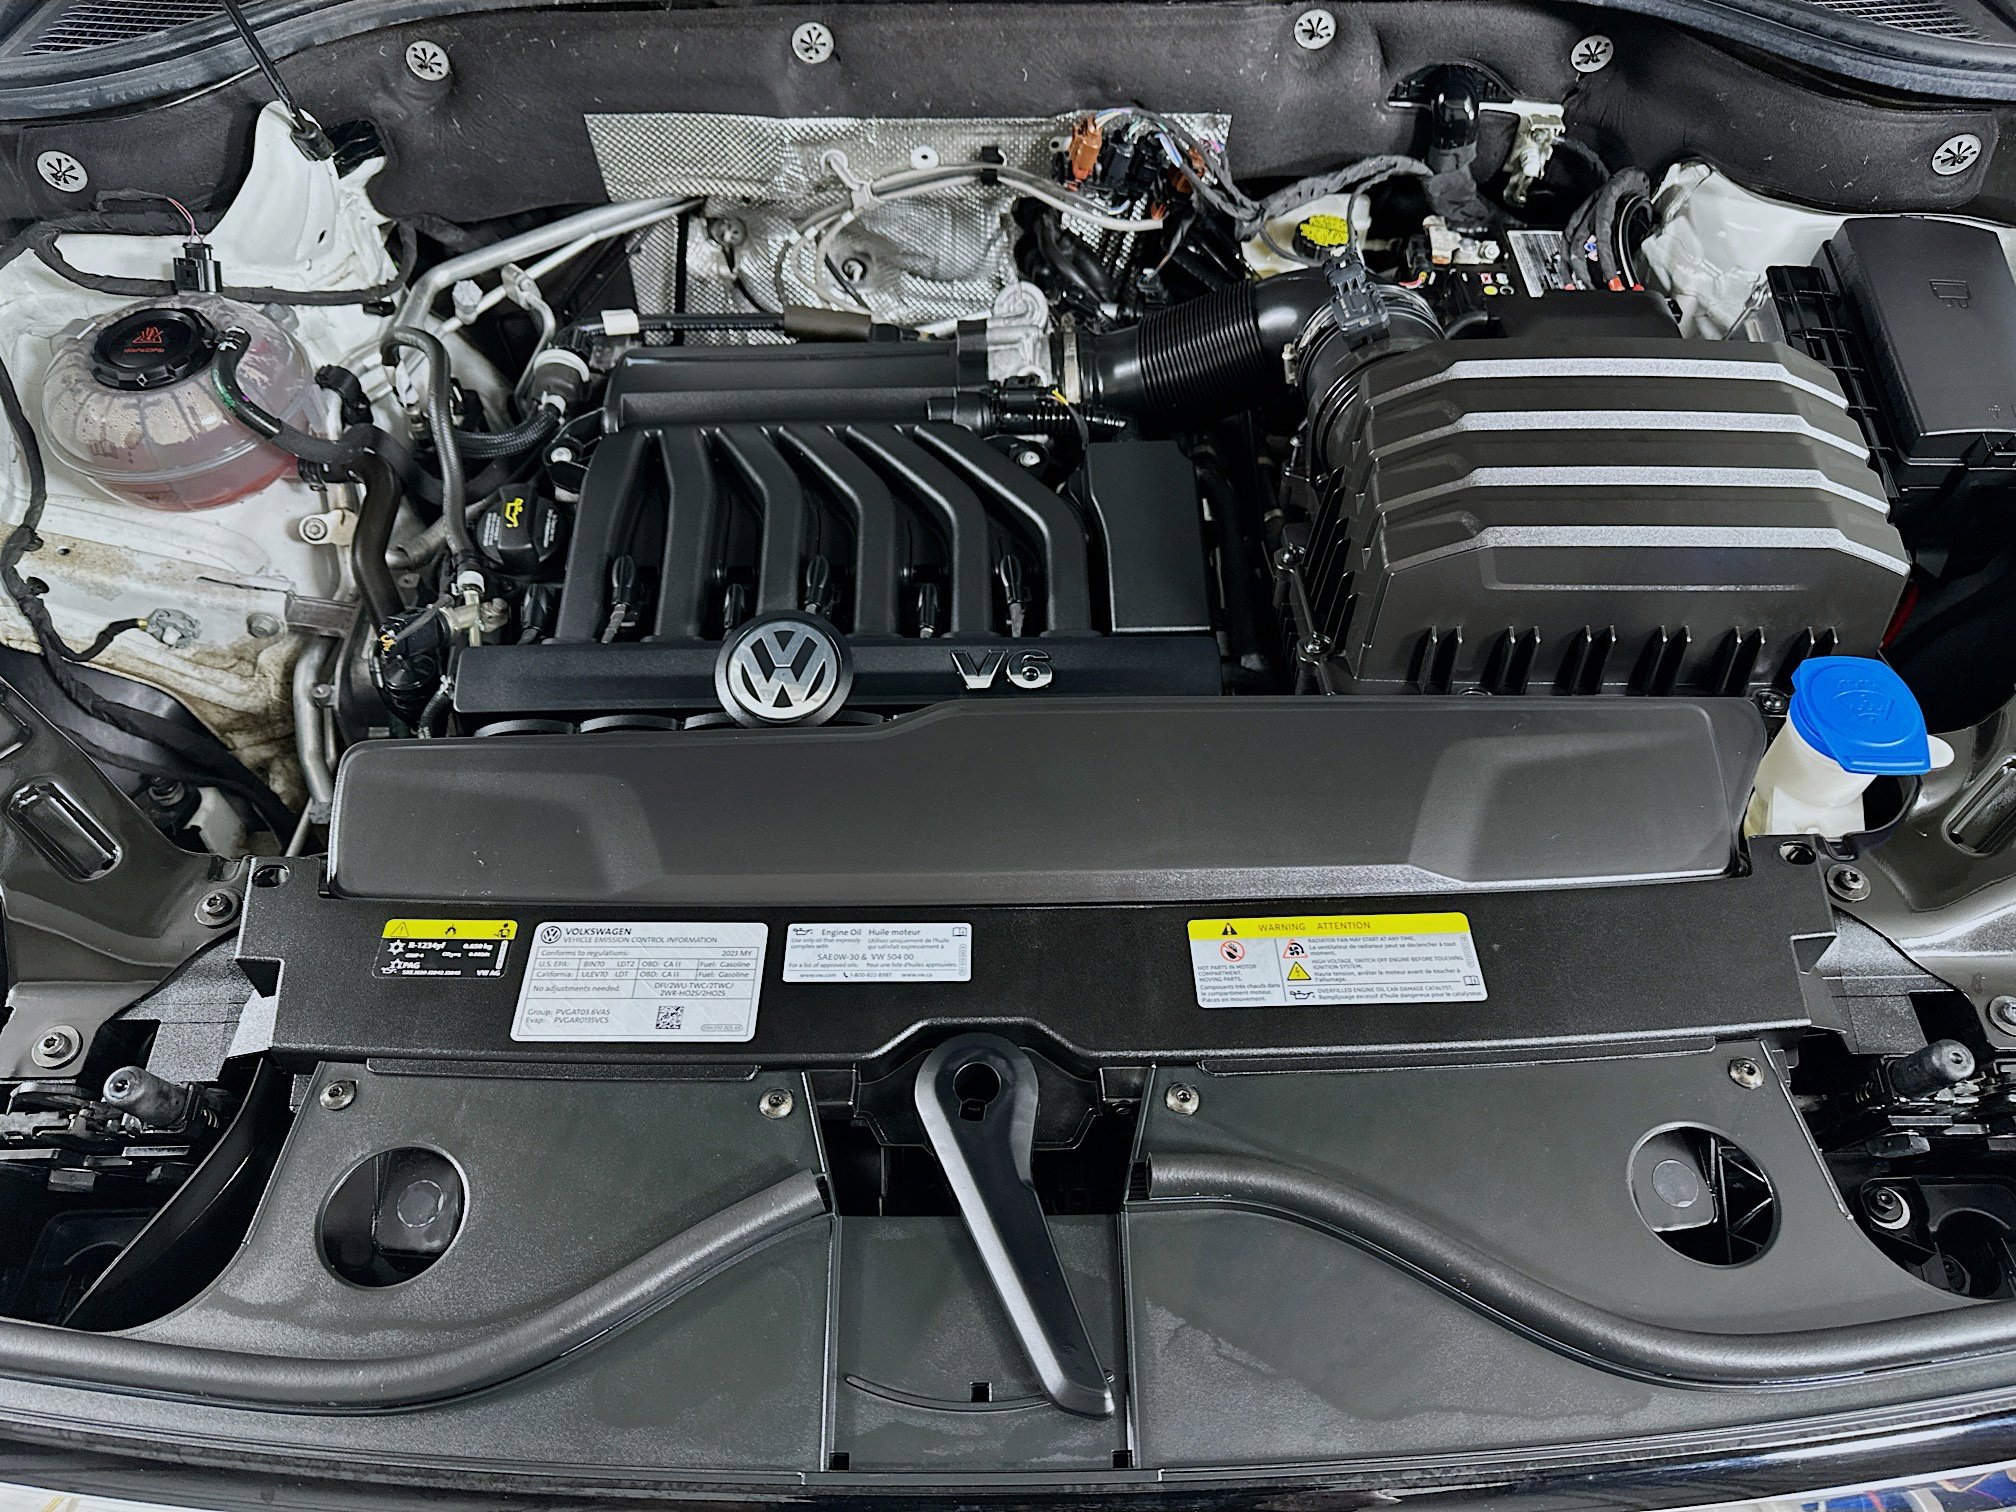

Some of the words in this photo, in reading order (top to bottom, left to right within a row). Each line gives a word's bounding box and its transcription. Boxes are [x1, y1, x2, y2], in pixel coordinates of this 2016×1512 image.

[950, 650, 1053, 690] V6
[1258, 922, 1306, 932] WARNING
[1317, 921, 1371, 930] ATTENTION
[821, 929, 848, 937] Engine
[545, 985, 591, 994] adjustments
